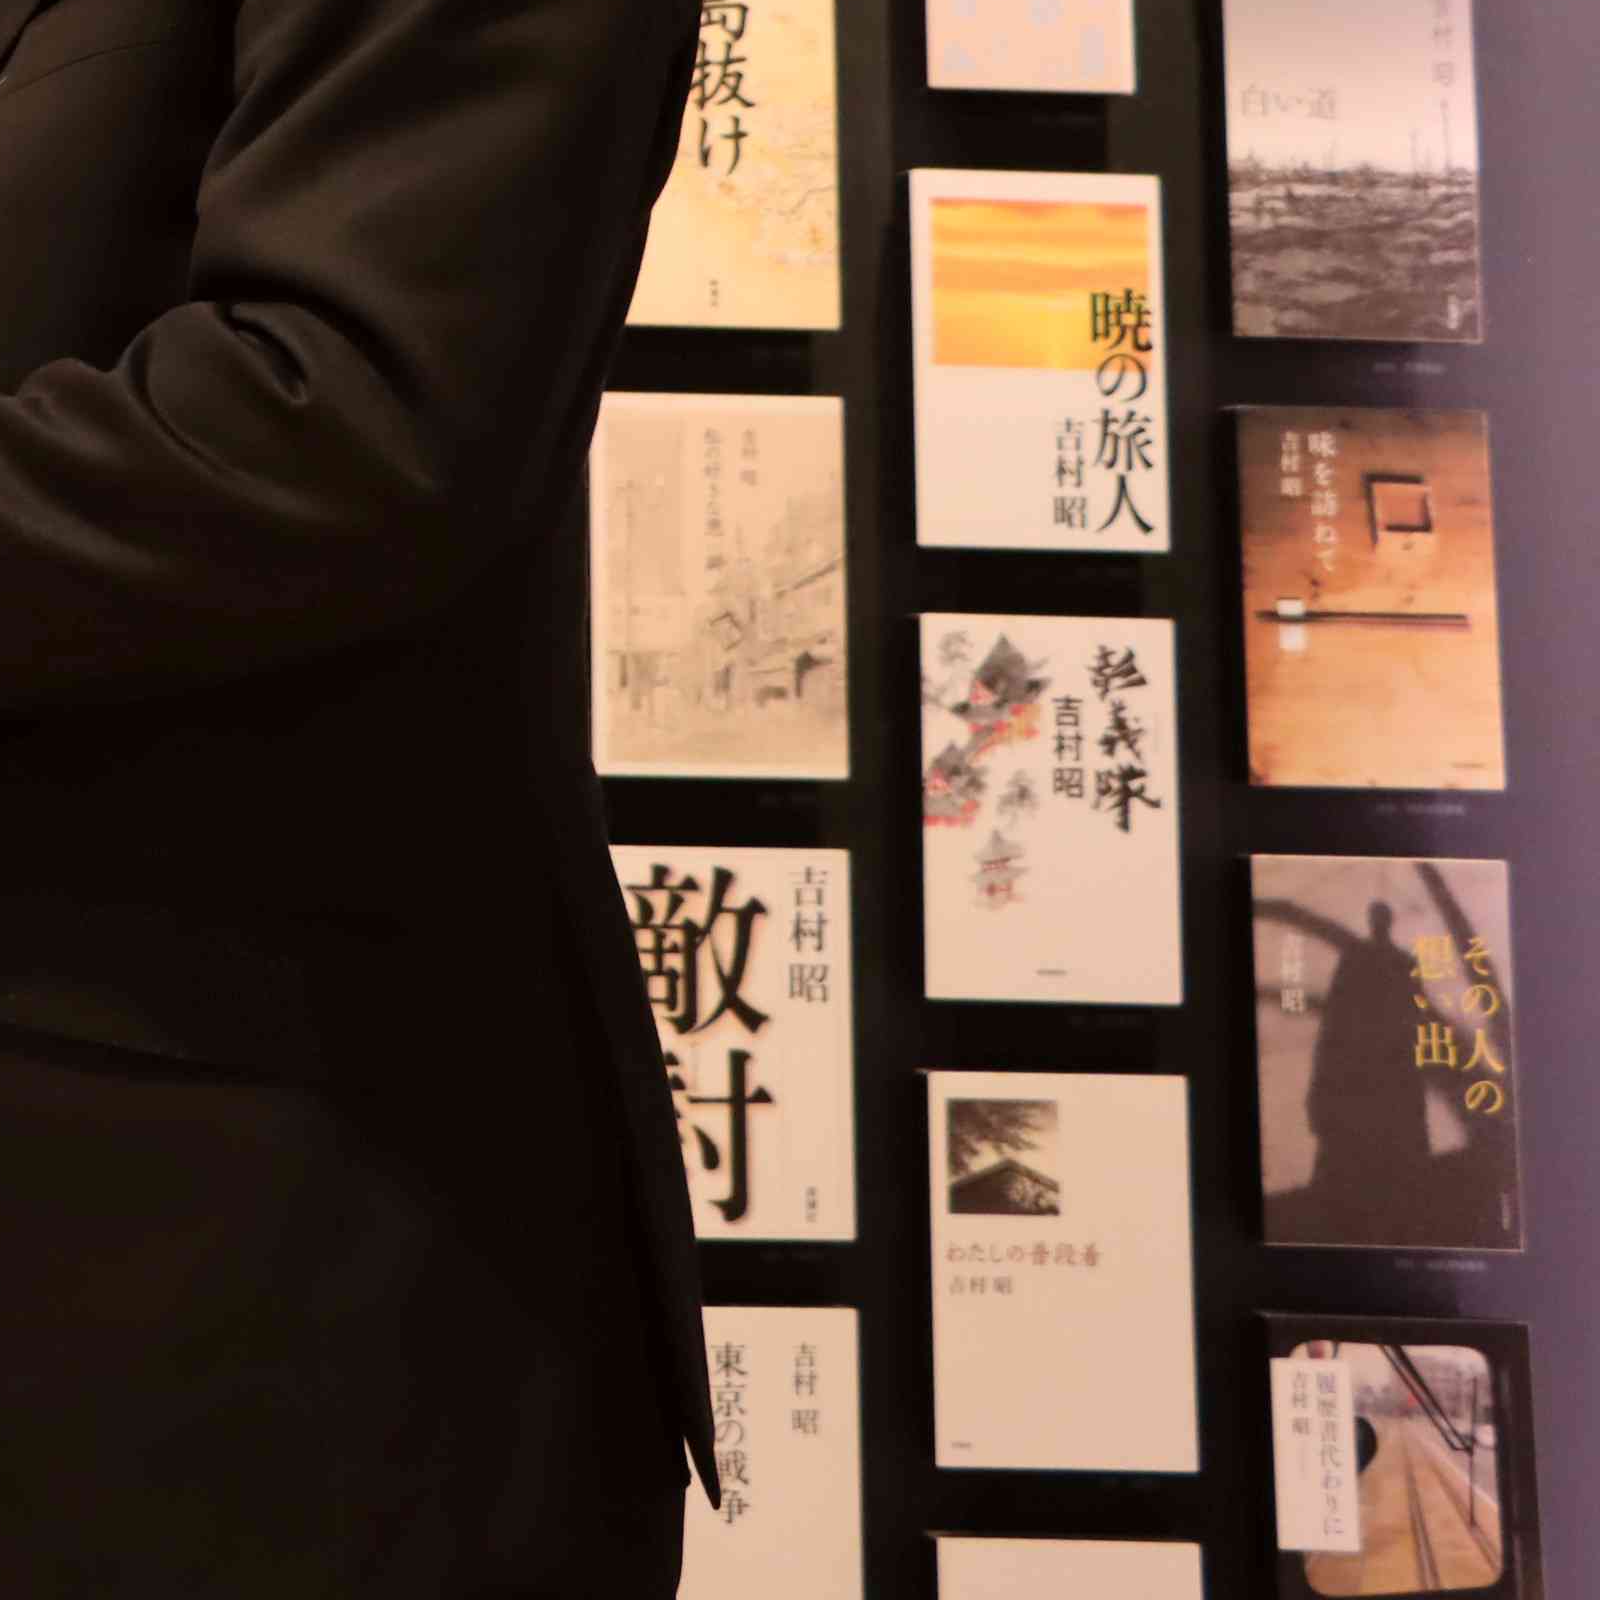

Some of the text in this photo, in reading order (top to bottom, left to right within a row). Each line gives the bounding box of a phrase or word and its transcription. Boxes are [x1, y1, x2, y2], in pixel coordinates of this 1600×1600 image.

[1054, 419, 1088, 529] 吉村昭
[1089, 288, 1156, 536] 暁の旅人
[1053, 696, 1084, 799] 吉村昭
[788, 866, 829, 1004] 吉村昭
[1462, 937, 1505, 1114] その人の
[946, 1242, 1100, 1268] わたしの普段着
[713, 1342, 750, 1525] 東京の戦争
[792, 1343, 819, 1436] 吉村昭
